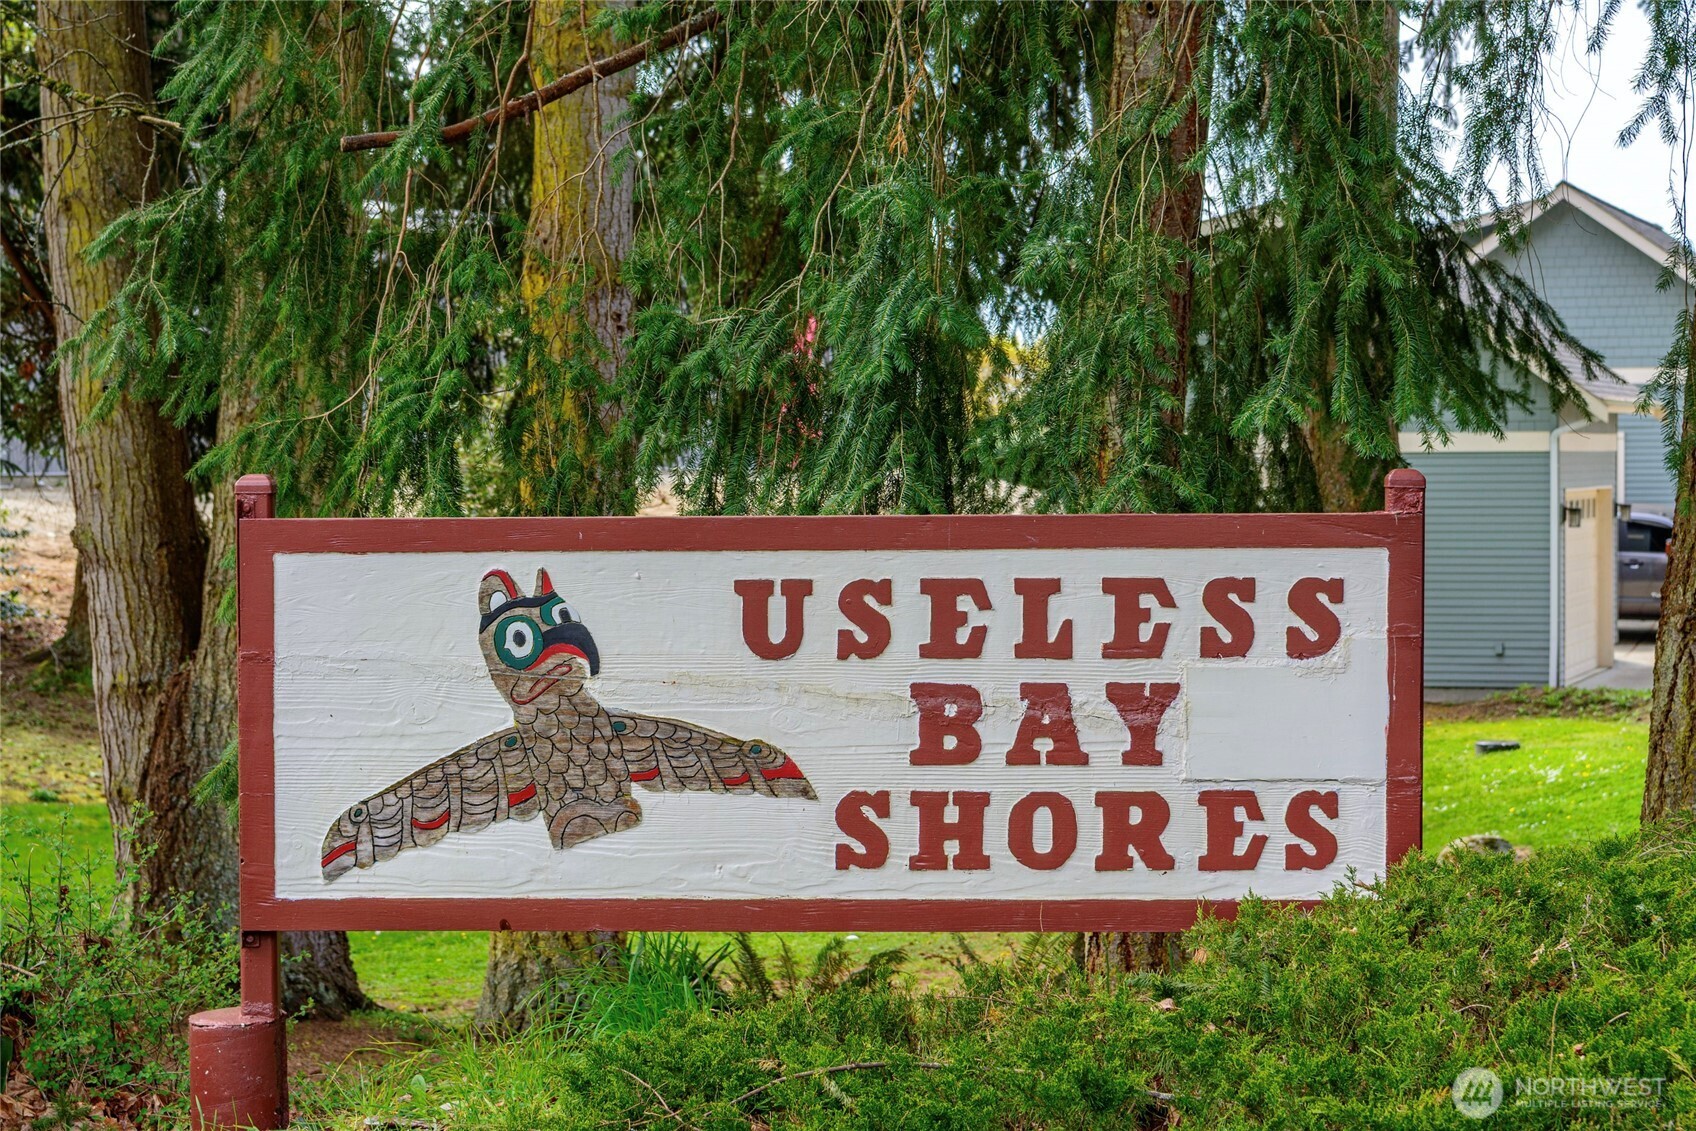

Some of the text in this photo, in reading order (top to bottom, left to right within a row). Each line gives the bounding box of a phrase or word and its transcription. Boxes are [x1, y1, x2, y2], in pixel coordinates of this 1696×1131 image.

[734, 577, 1344, 660] USELESS
[909, 682, 1180, 766] BAY
[835, 790, 1339, 872] SHORES
